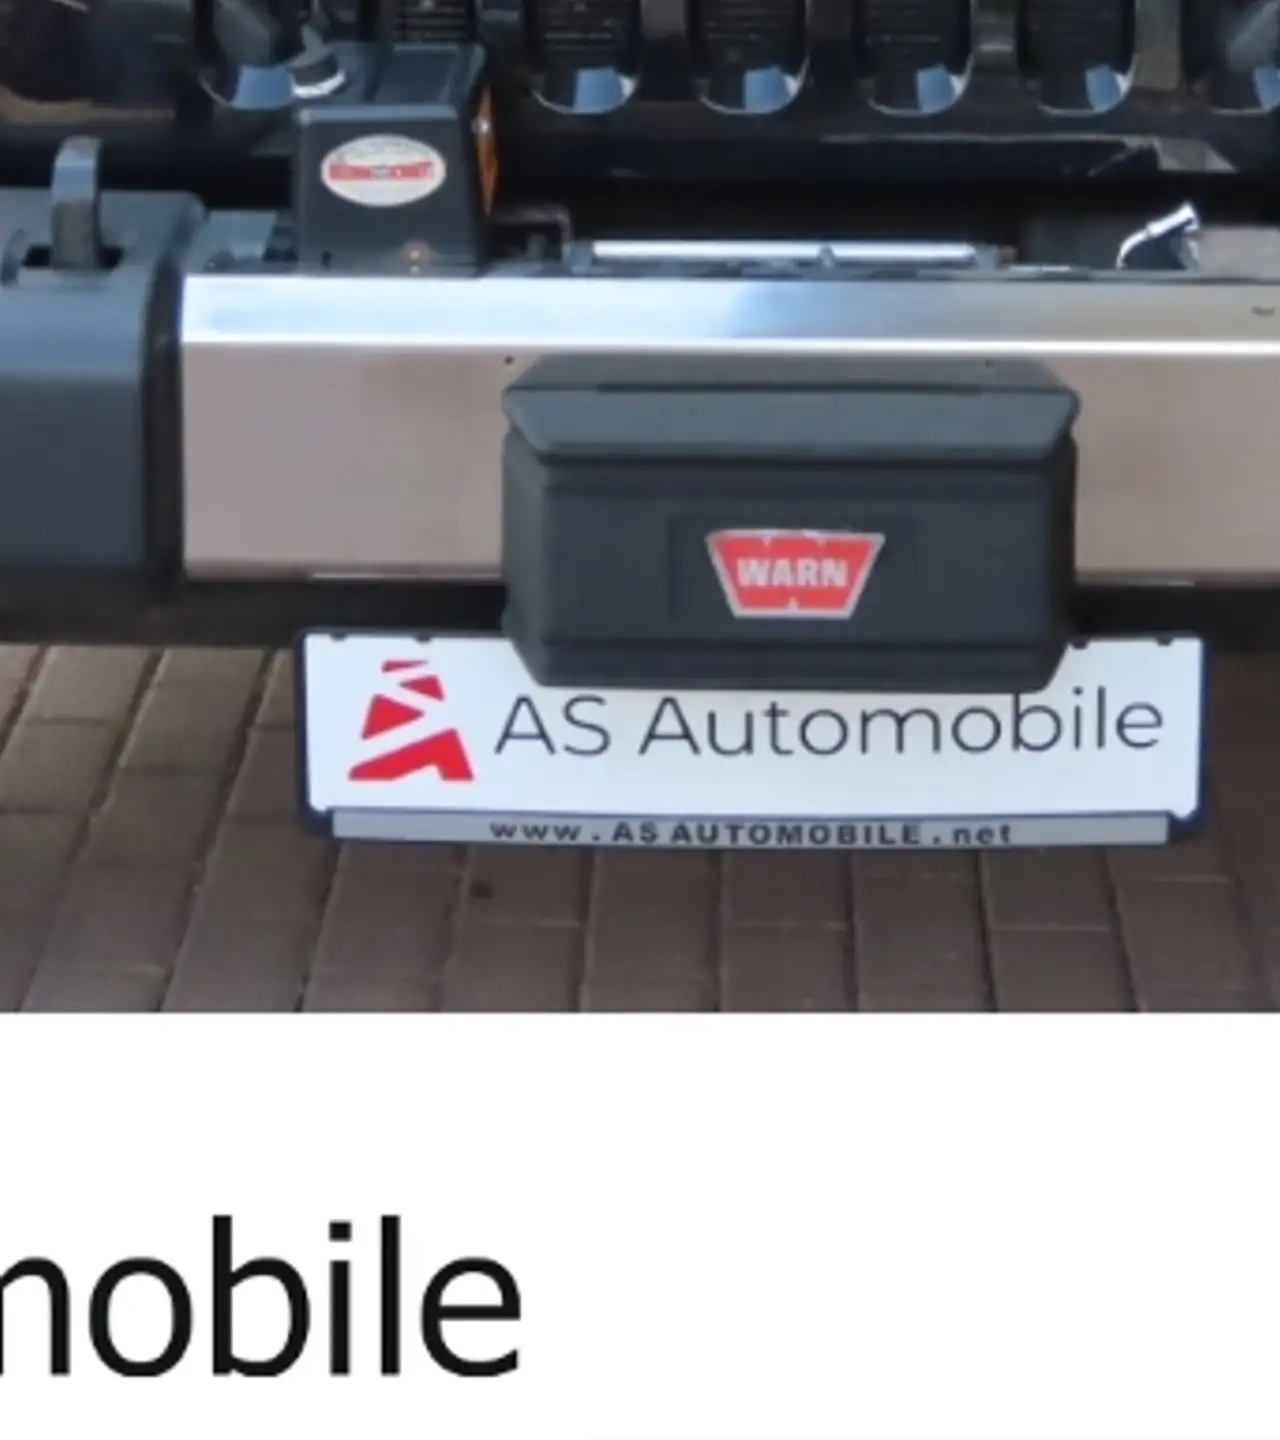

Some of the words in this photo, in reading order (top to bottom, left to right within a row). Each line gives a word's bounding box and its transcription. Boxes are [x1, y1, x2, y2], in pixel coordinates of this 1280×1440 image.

[736, 556, 849, 589] WARN
[494, 694, 612, 757] AS
[638, 687, 1164, 757] Automobile
